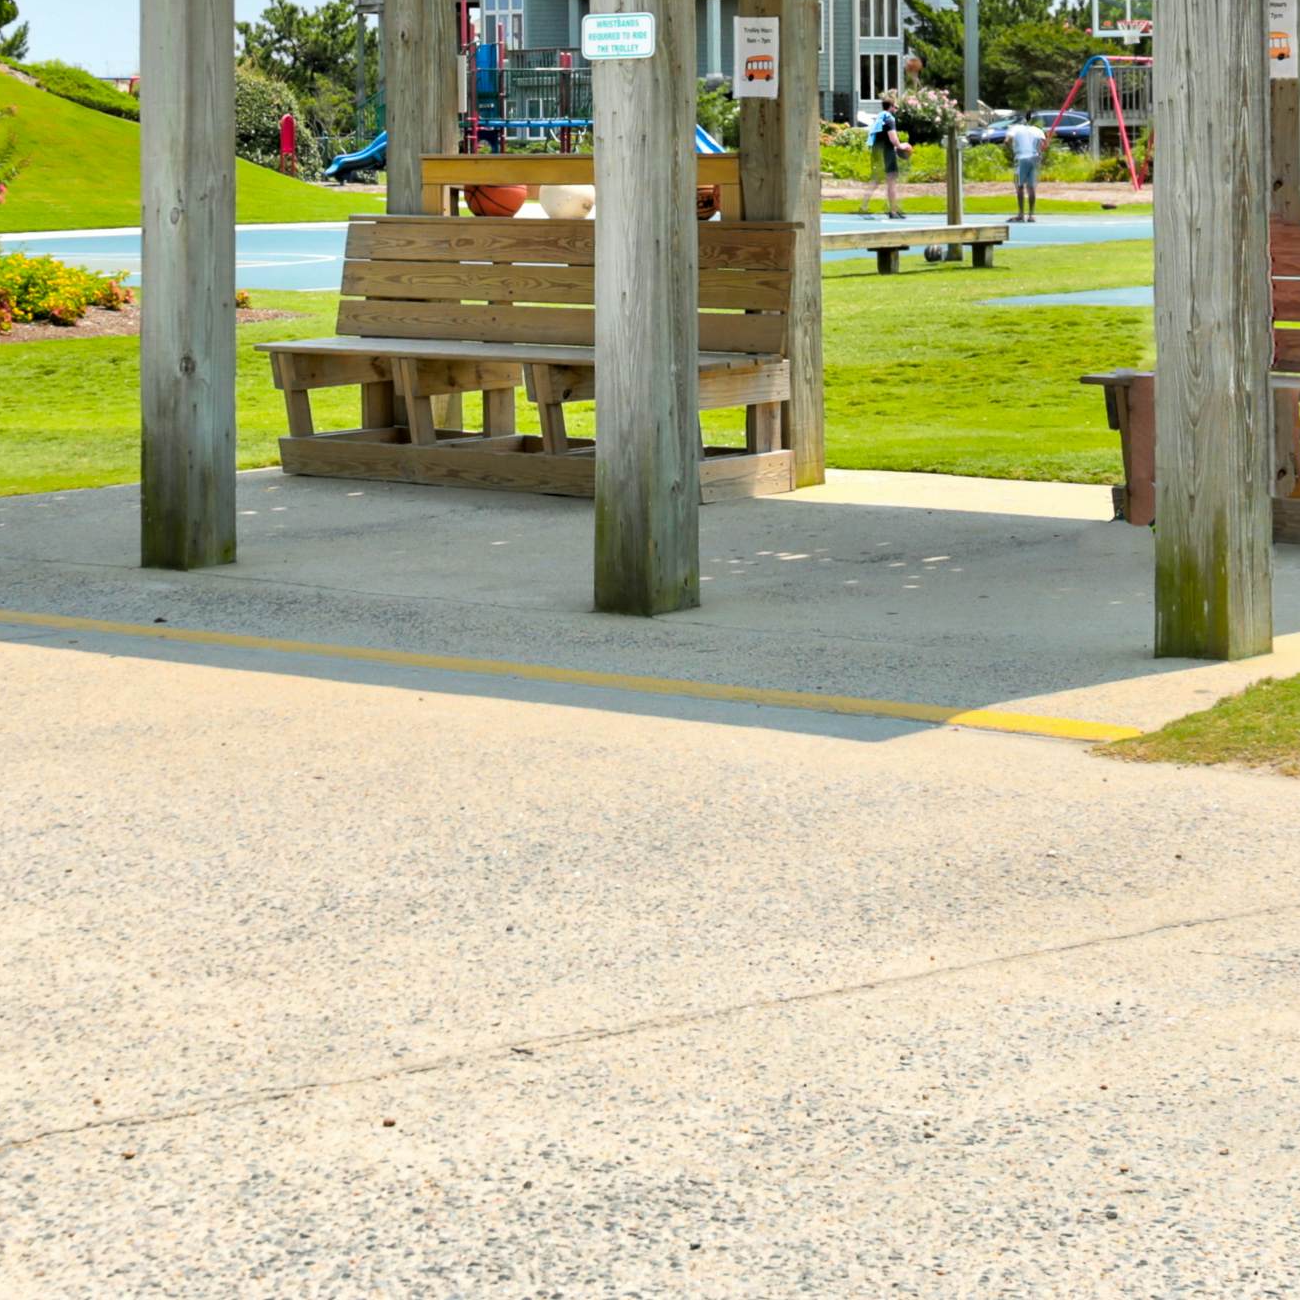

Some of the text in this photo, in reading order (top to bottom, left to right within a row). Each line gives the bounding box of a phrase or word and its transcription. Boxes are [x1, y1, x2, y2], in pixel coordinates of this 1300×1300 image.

[596, 19, 639, 28] WRISTBANDS
[588, 31, 647, 41] REQUIRED TO RIDE
[597, 44, 639, 52] THE TROLLEY
